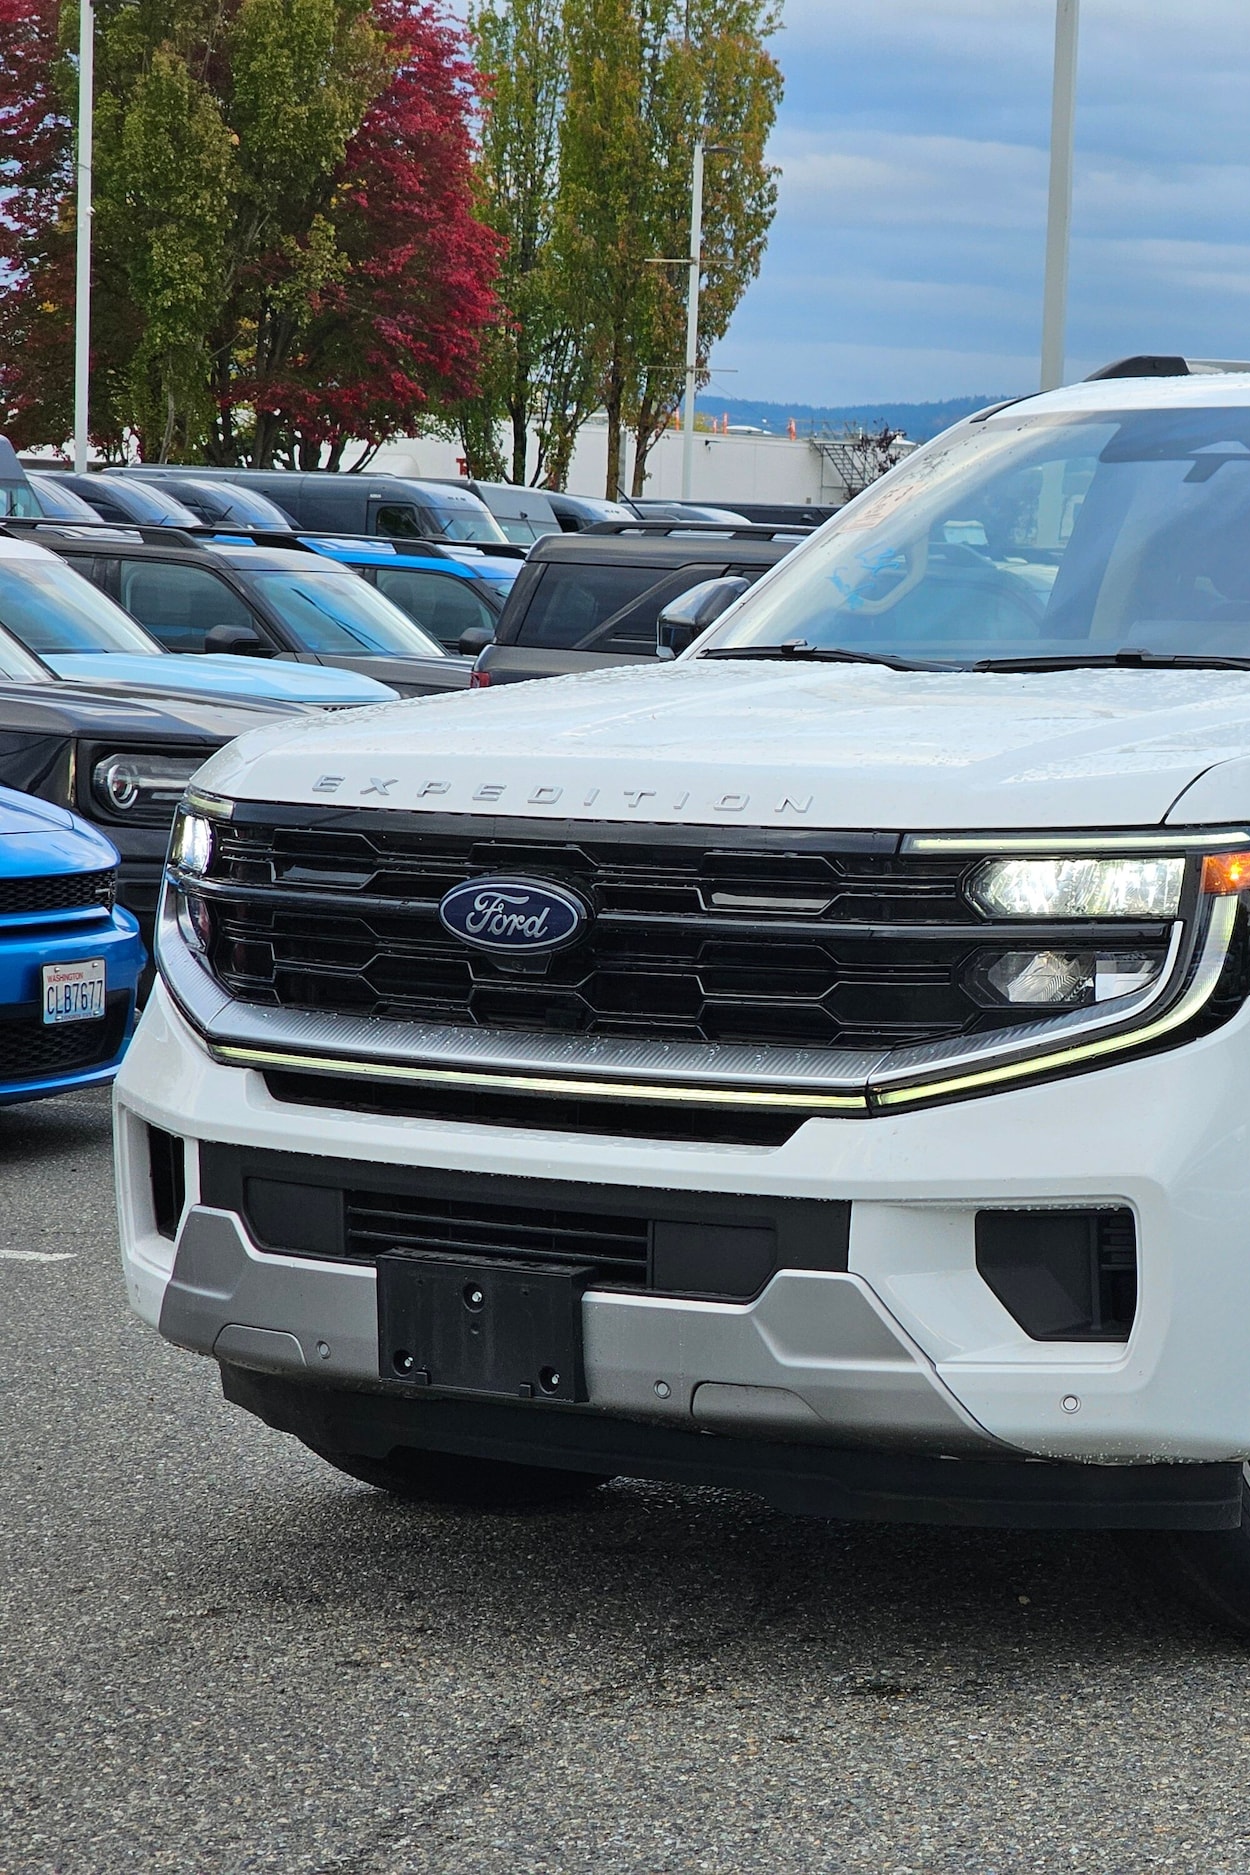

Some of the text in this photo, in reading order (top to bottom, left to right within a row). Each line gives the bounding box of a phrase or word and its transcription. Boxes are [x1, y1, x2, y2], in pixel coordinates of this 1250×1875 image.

[312, 775, 815, 814] EXPEDITION
[465, 892, 551, 940] Ford
[47, 972, 84, 983] WASHINGTON
[47, 979, 103, 1015] CLB7677
